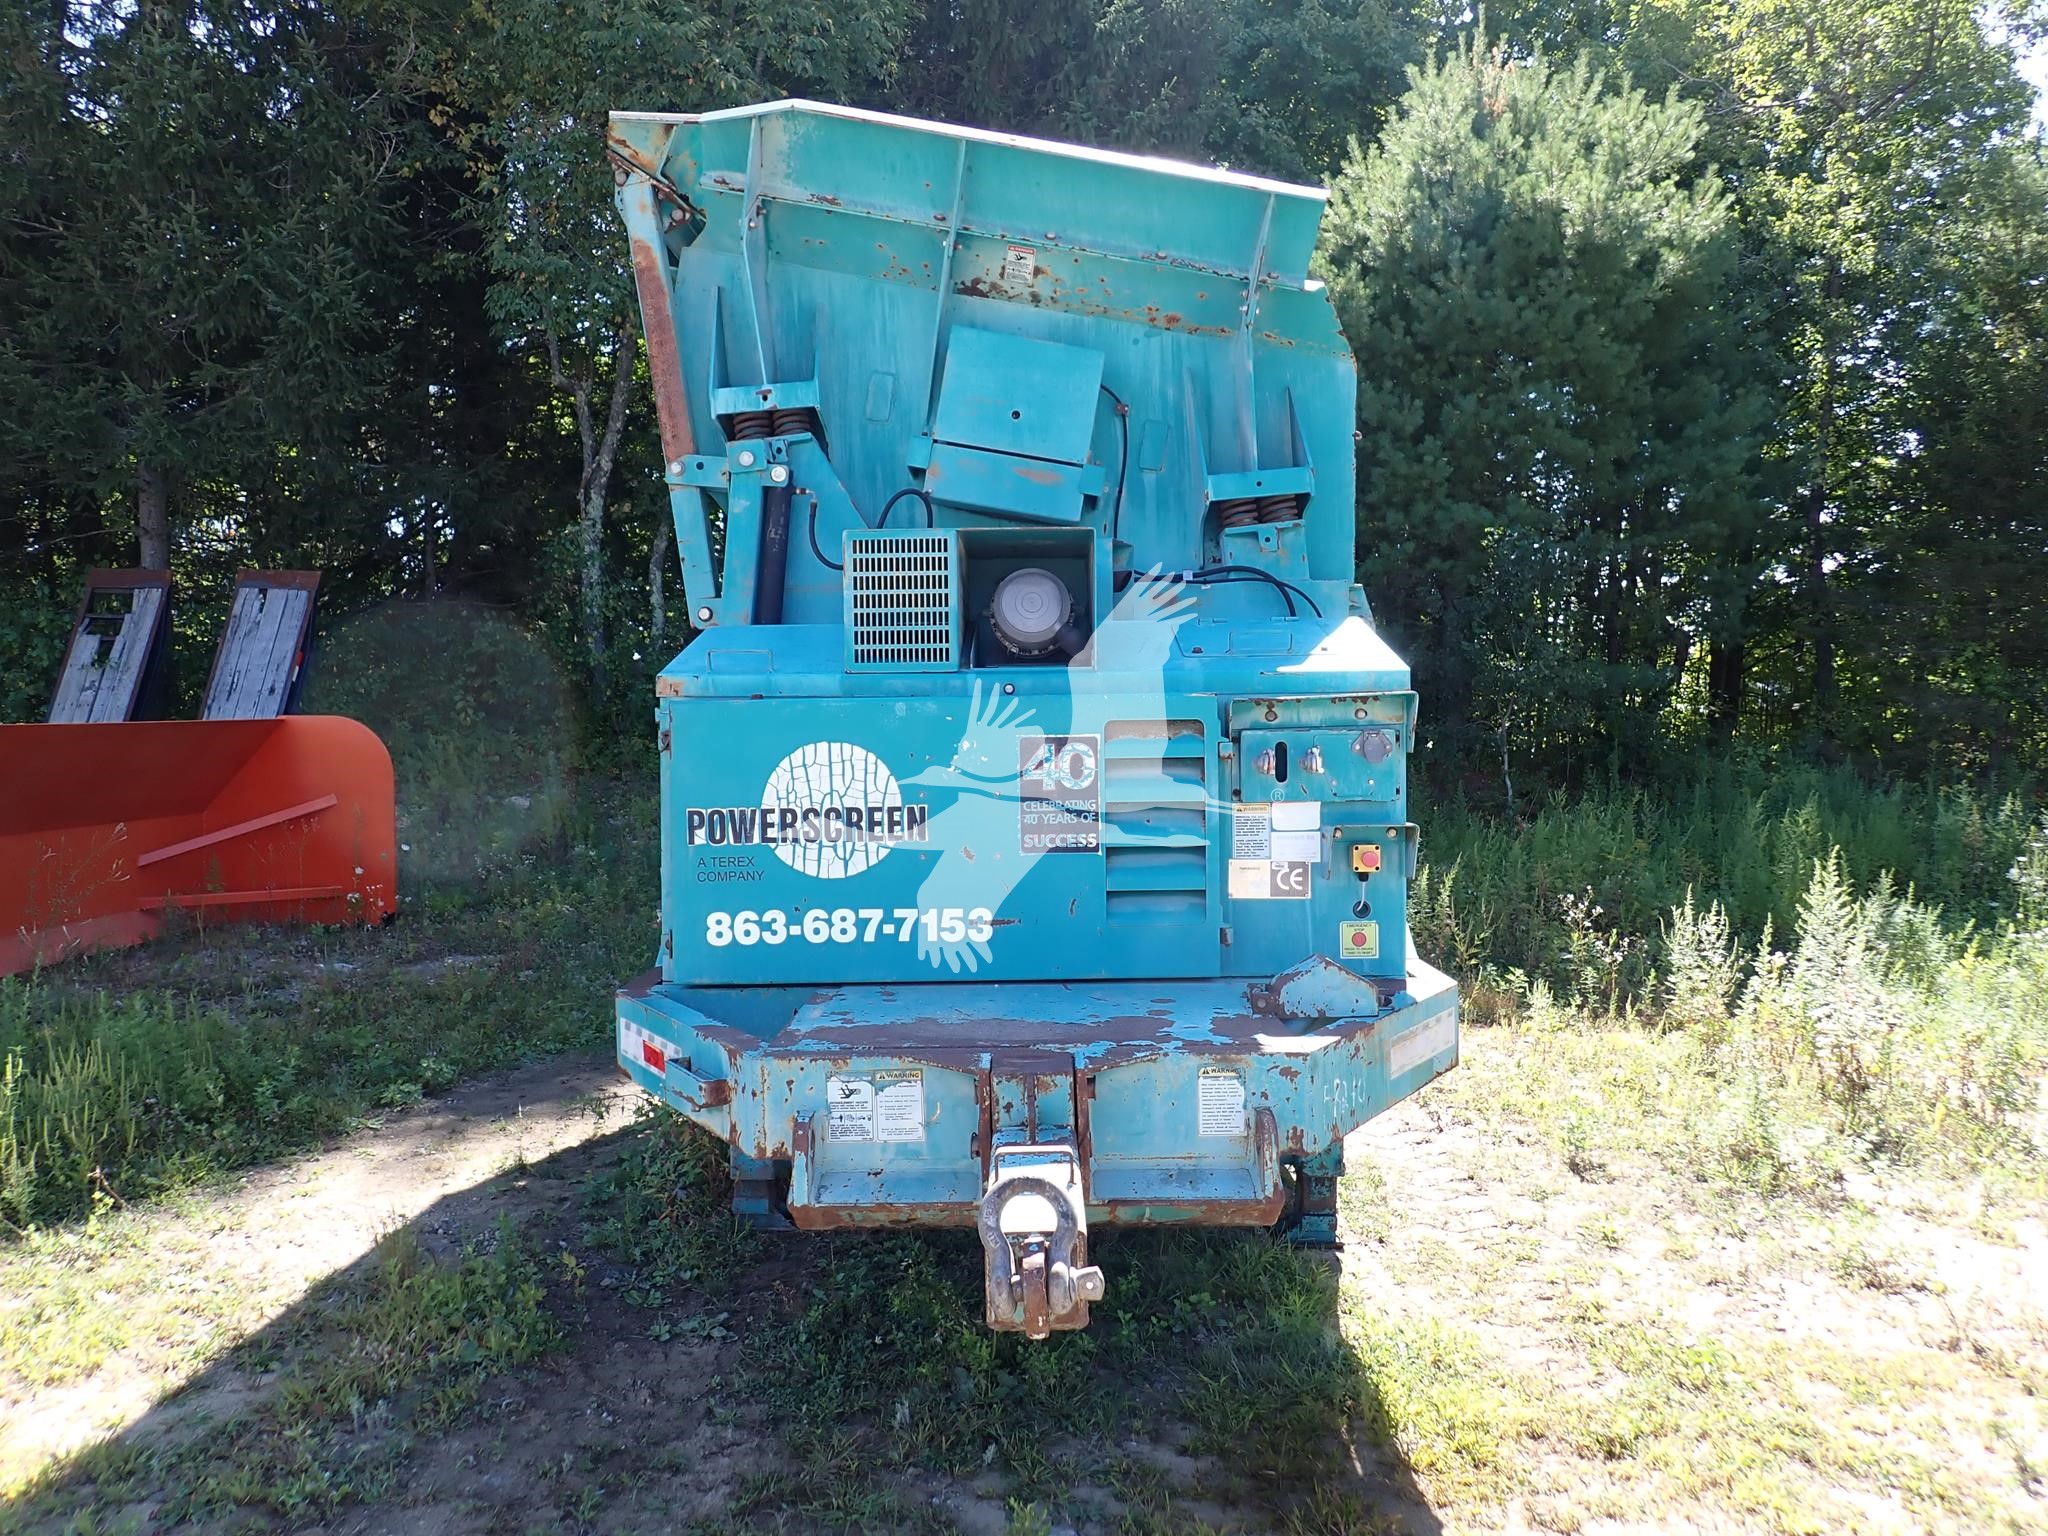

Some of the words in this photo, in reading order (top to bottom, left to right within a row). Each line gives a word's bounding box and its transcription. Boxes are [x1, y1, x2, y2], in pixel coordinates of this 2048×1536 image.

[1022, 742, 1096, 790] 40
[1023, 800, 1096, 811] CELEBRATING
[1023, 814, 1039, 824] 40
[1041, 813, 1077, 824] YEARS
[1080, 812, 1096, 823] OF
[686, 804, 929, 846] POWERSCREEN
[1023, 833, 1097, 848] SUCCESS
[697, 857, 707, 868] A
[710, 856, 755, 867] TEREX
[697, 870, 764, 882] COMPANY
[706, 907, 993, 946] 863-687-7153
